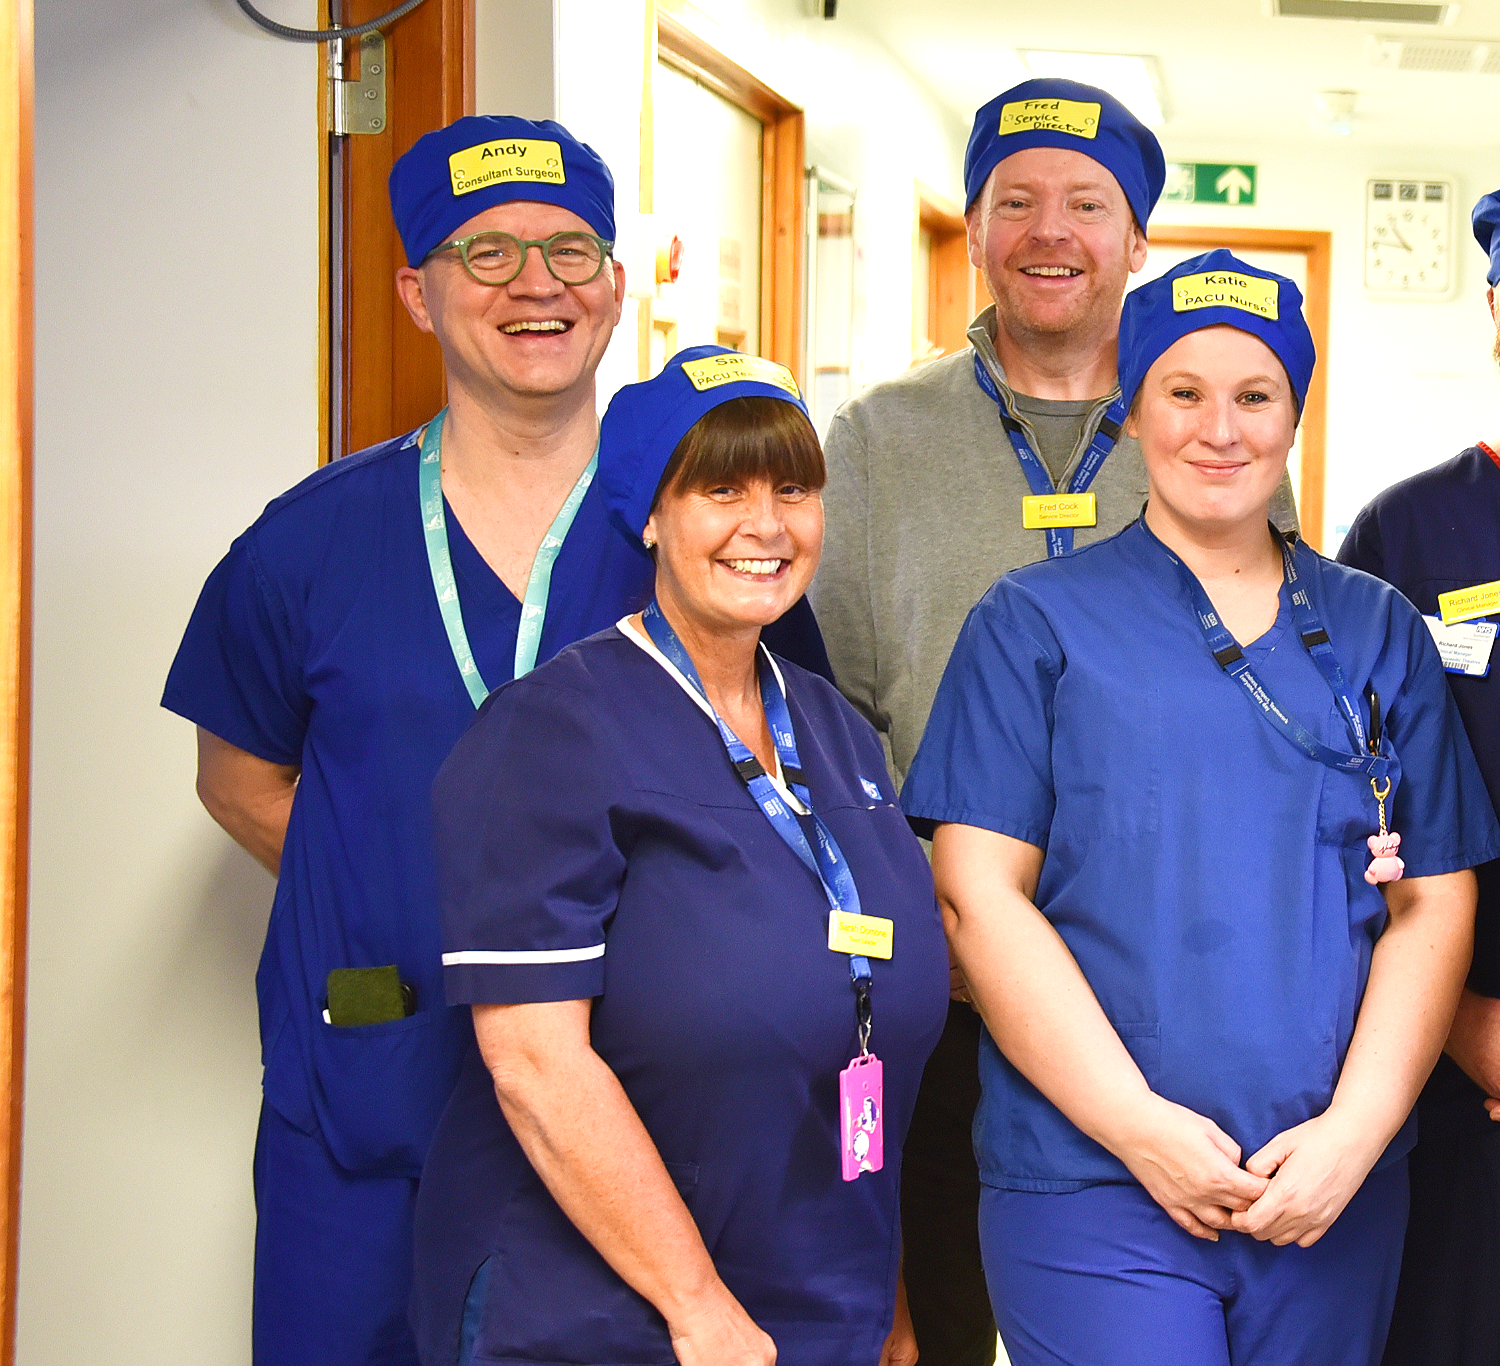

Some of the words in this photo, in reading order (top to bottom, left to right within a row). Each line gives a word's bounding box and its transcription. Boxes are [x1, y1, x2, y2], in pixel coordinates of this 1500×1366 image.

[1024, 101, 1060, 110] Fred
[1014, 114, 1060, 126] Service
[1033, 122, 1086, 134] Director
[481, 144, 528, 160] Andy
[457, 167, 513, 190] Consultant
[516, 166, 561, 179] Surgeon
[1205, 275, 1248, 288] Katie
[1185, 294, 1224, 306] PACU
[1230, 294, 1268, 312] Nurse
[697, 372, 730, 386] PACU
[1039, 504, 1056, 512] Fred
[1058, 502, 1078, 510] Cock
[1448, 594, 1478, 606] Richard
[1456, 605, 1475, 613] Clinical
[1240, 674, 1254, 693] Everyone,
[1253, 691, 1263, 704] Every
[1262, 702, 1270, 712] day
[1257, 686, 1270, 704] Respect,
[1270, 702, 1289, 724] Teamwork
[839, 922, 859, 932] Sarah
